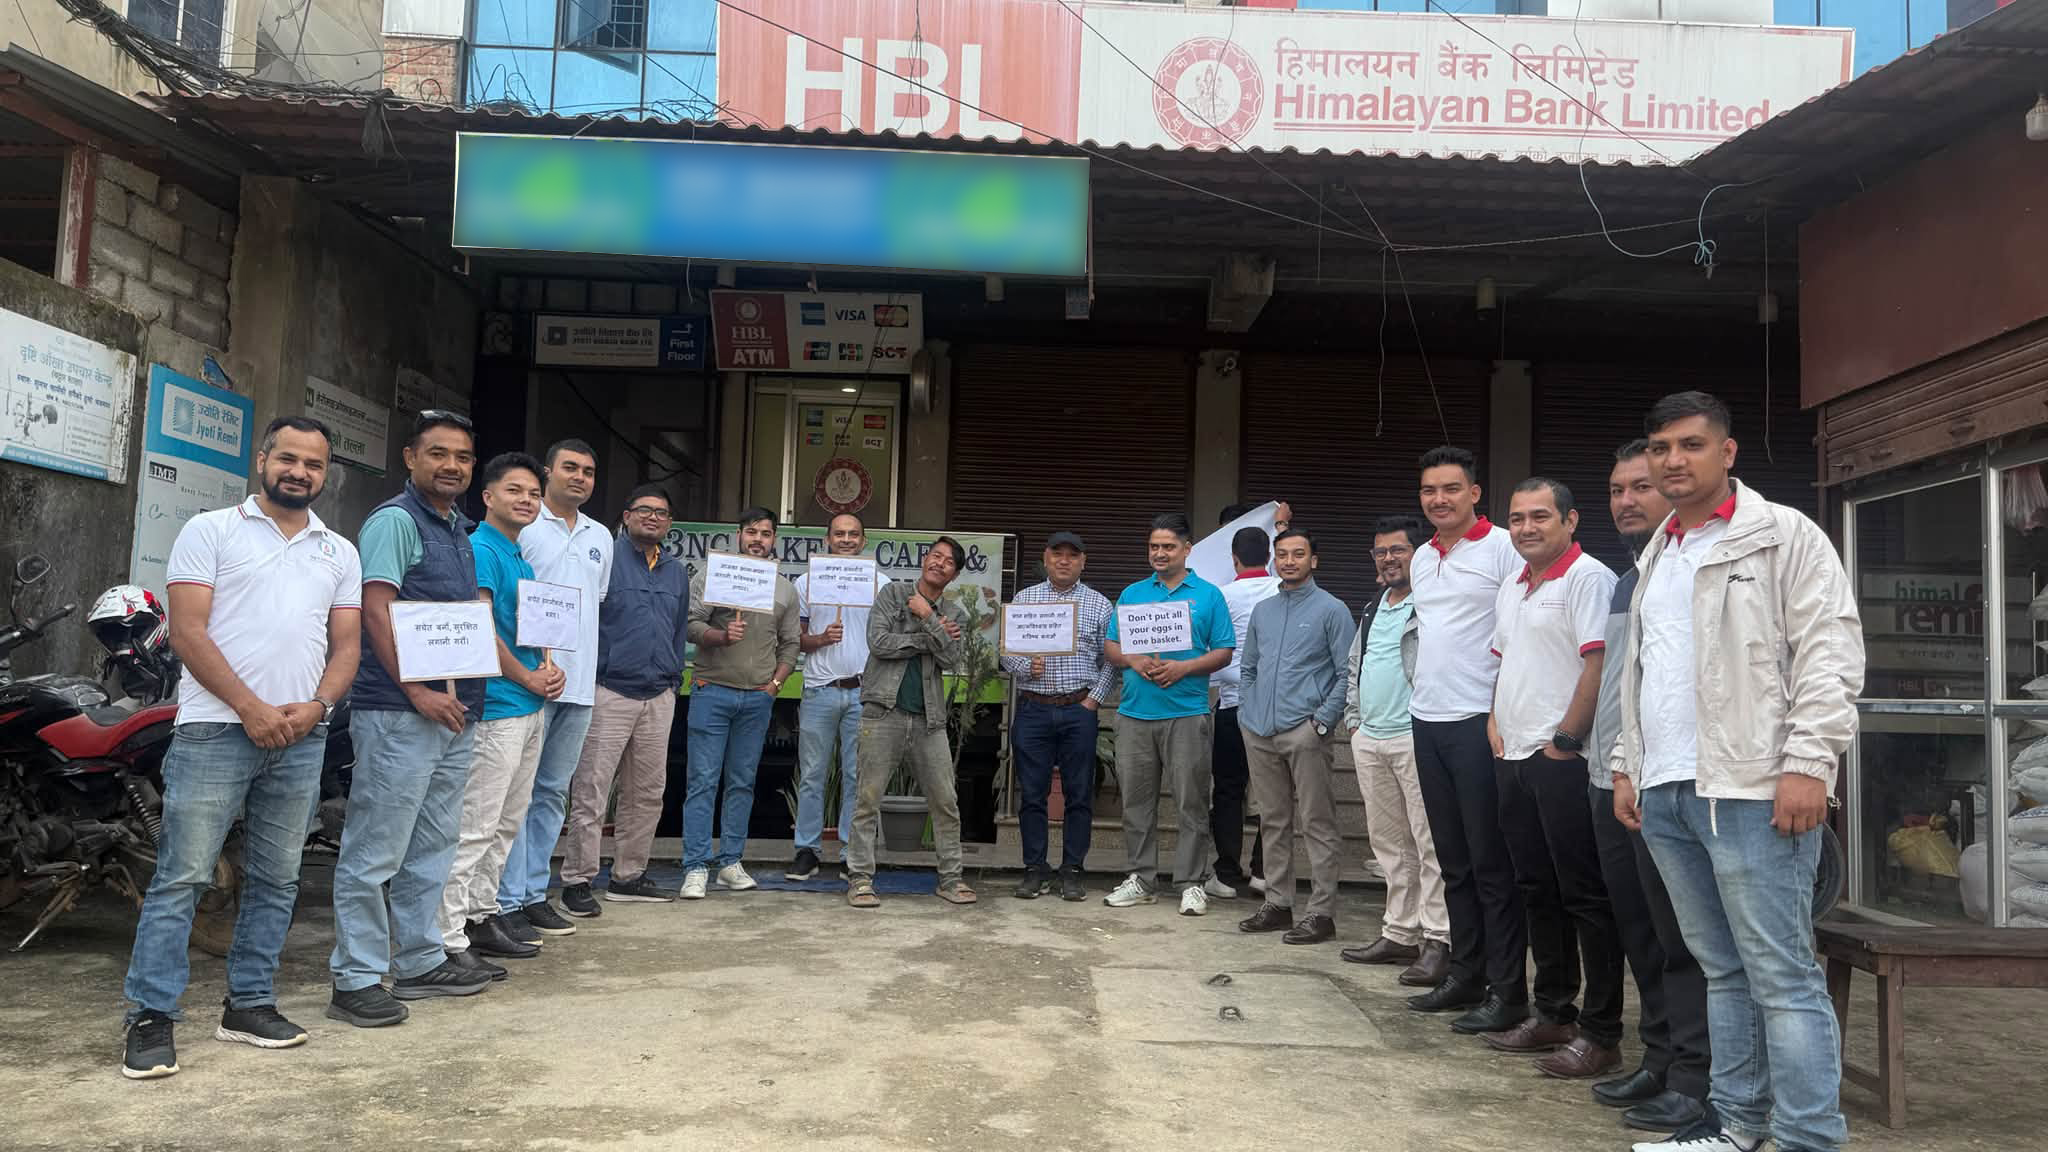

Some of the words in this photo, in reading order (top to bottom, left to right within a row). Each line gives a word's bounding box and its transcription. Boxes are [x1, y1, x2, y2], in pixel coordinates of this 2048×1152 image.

[1274, 36, 1420, 80] हिमालयन
[1437, 40, 1492, 81] बैंक
[1512, 43, 1640, 89] लिमिटेड
[784, 34, 1023, 140] HBL
[1273, 83, 1490, 131] Himalayan
[1504, 88, 1609, 127] Bank
[1622, 93, 1770, 132] Limited
[835, 309, 866, 320] VISA
[731, 326, 772, 340] HBL
[670, 338, 695, 348] First
[667, 351, 696, 361] Floor
[732, 348, 775, 366] ATM
[872, 346, 906, 359] SCT
[198, 402, 219, 421] ज्योति
[196, 420, 216, 440] Jyoti
[217, 427, 238, 446] Remit
[153, 466, 175, 480] IME
[876, 540, 932, 568] CAF
[965, 544, 987, 571] &
[1128, 612, 1152, 623] Don't
[1155, 612, 1170, 623] put
[1171, 610, 1183, 619] all
[1895, 604, 1984, 633] remi
[1128, 626, 1149, 635] your
[1151, 624, 1173, 635] eggs
[1174, 622, 1183, 632] in
[1132, 637, 1149, 646] one
[1151, 635, 1183, 645] basket.
